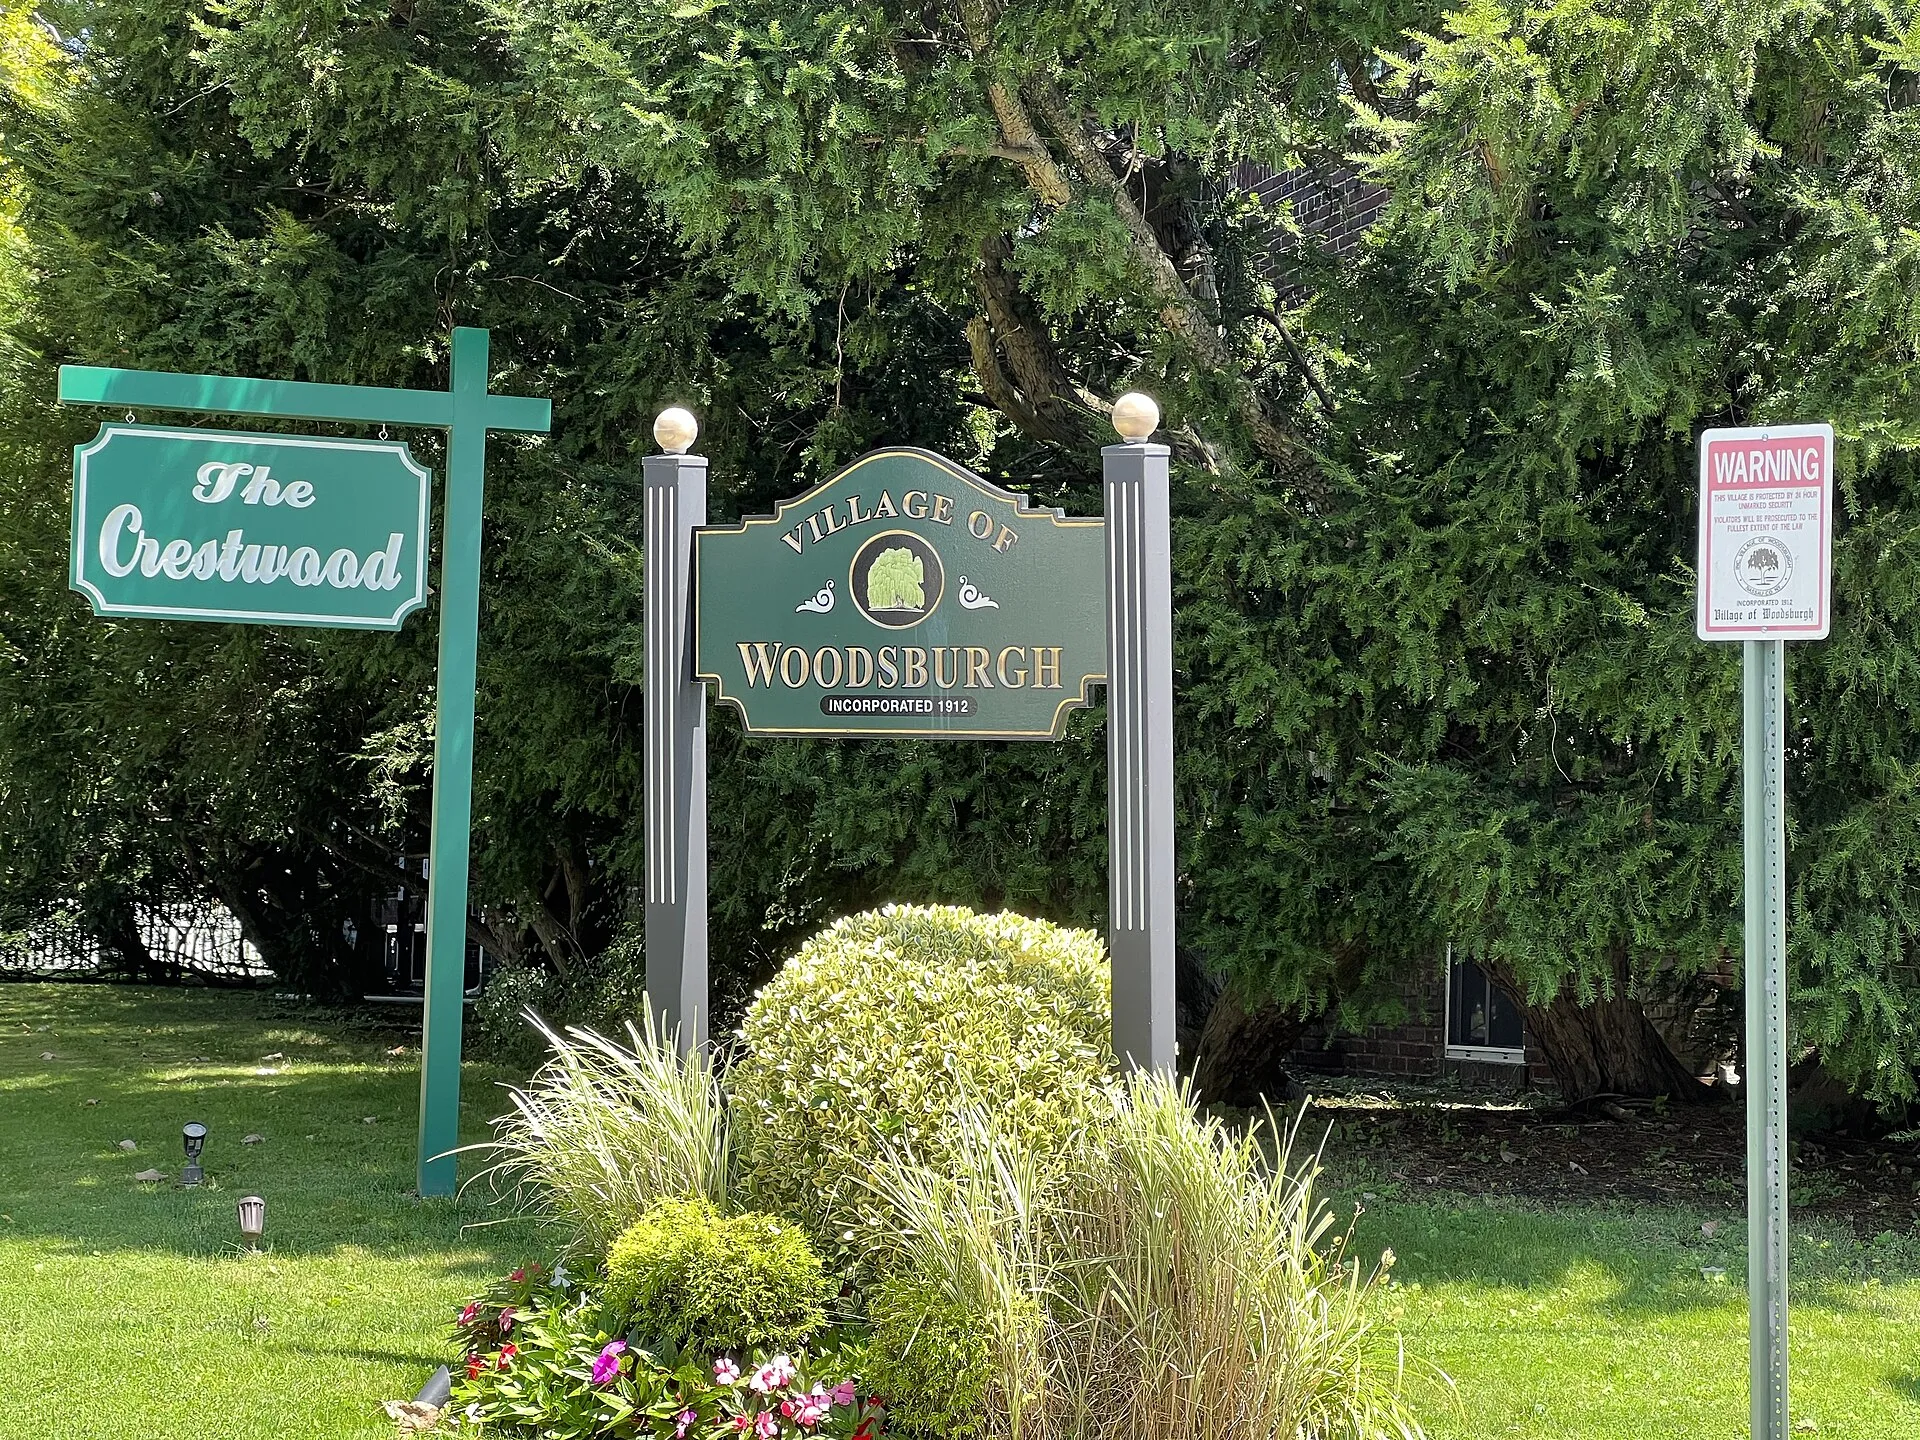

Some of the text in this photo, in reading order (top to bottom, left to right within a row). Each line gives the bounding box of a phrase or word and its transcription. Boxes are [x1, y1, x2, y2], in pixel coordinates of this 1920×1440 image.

[1714, 447, 1820, 484] WARNING
[191, 461, 317, 508] The
[1714, 490, 1818, 502] THIS VILLAGE IS PROTECTED BY 24 HOUR
[1738, 501, 1793, 510] UNMARKED SECURITY
[780, 489, 1020, 556] VILLAGE OF
[1713, 515, 1741, 524] VIOLATORS
[1742, 515, 1754, 523] WILL
[1764, 513, 1797, 522] PROSECUTED
[1798, 513, 1806, 521] TO
[1807, 513, 1818, 521] THE
[1727, 522, 1803, 533] FULLEST EXTENT OF THE LAW
[99, 503, 405, 591] Crestwood
[1736, 599, 1779, 607] INCORPORATED
[1714, 607, 1814, 622] Village of Woodsburgh
[736, 641, 1064, 691] WOODSBURGH
[828, 698, 969, 713] INCORPORATED 1912
